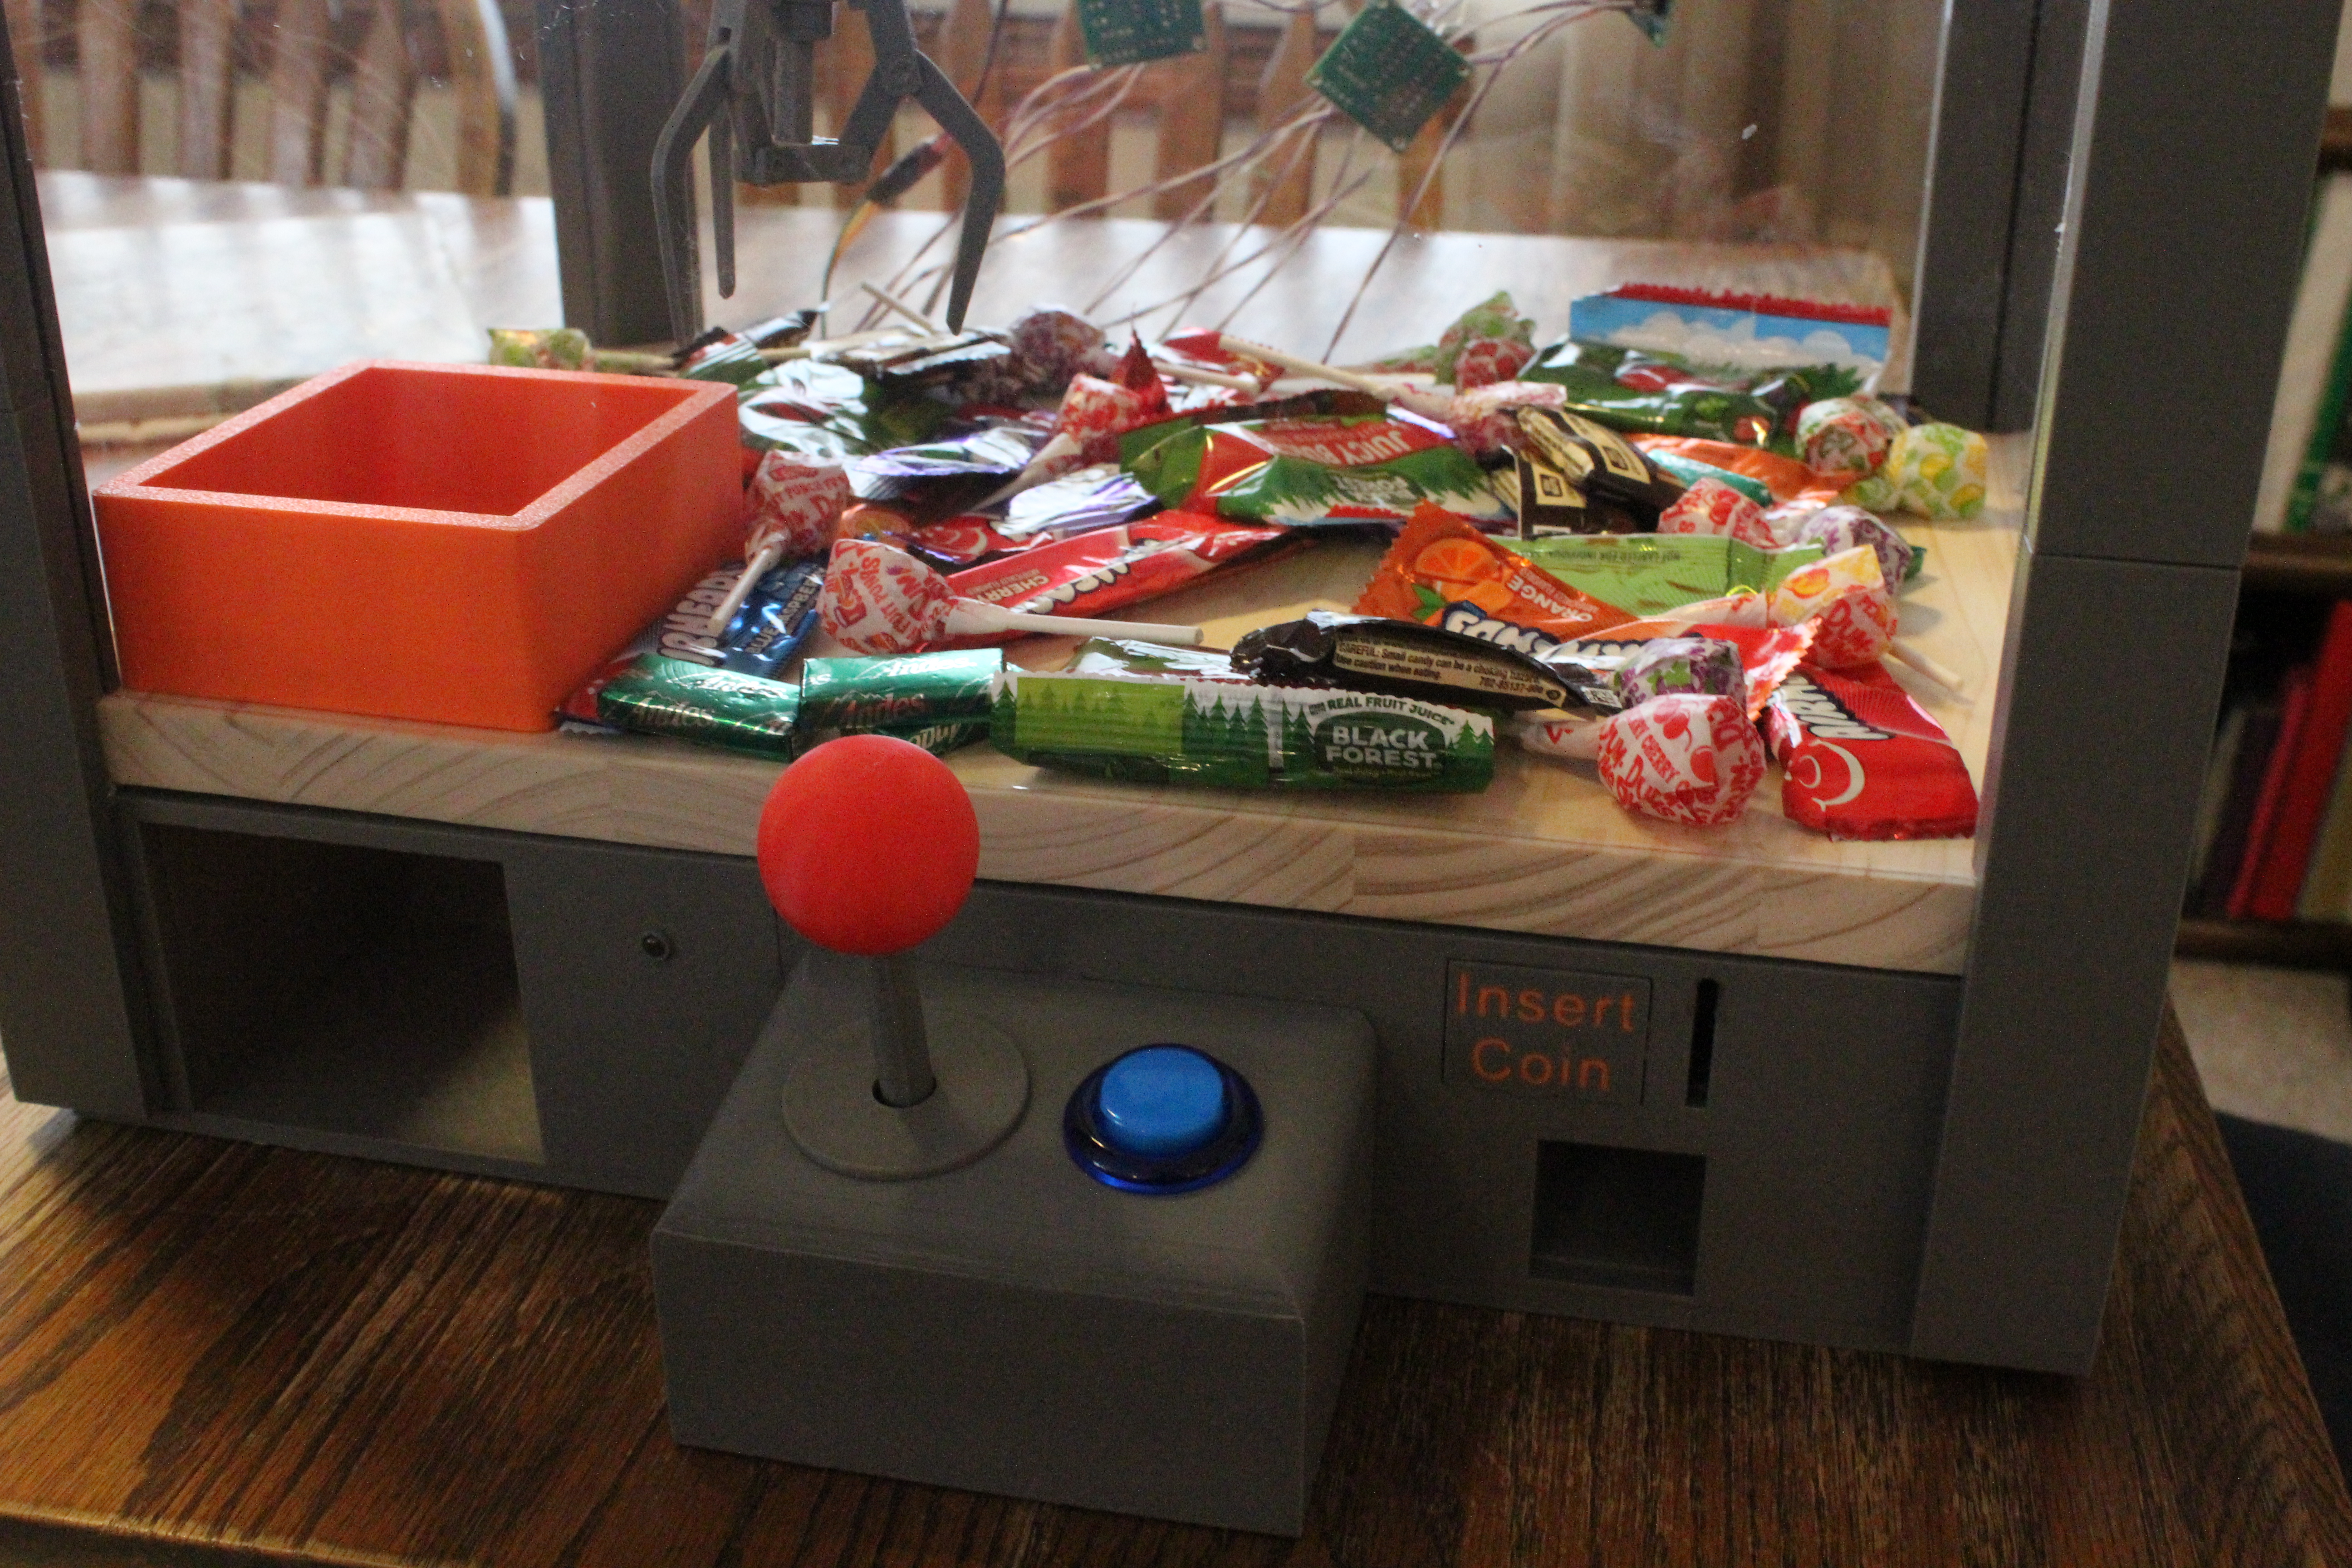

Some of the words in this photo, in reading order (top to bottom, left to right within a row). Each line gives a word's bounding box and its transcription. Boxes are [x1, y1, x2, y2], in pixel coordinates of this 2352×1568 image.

[1507, 574, 1593, 622] ORANGE
[1328, 696, 1361, 710] REAL
[1366, 696, 1407, 710] FRUIT
[1326, 746, 1437, 769] FOREST
[1333, 726, 1429, 751] BLACK
[1642, 734, 1681, 783] CHERRY
[1457, 970, 1634, 1033] Insert
[1470, 1037, 1611, 1090] Coin
